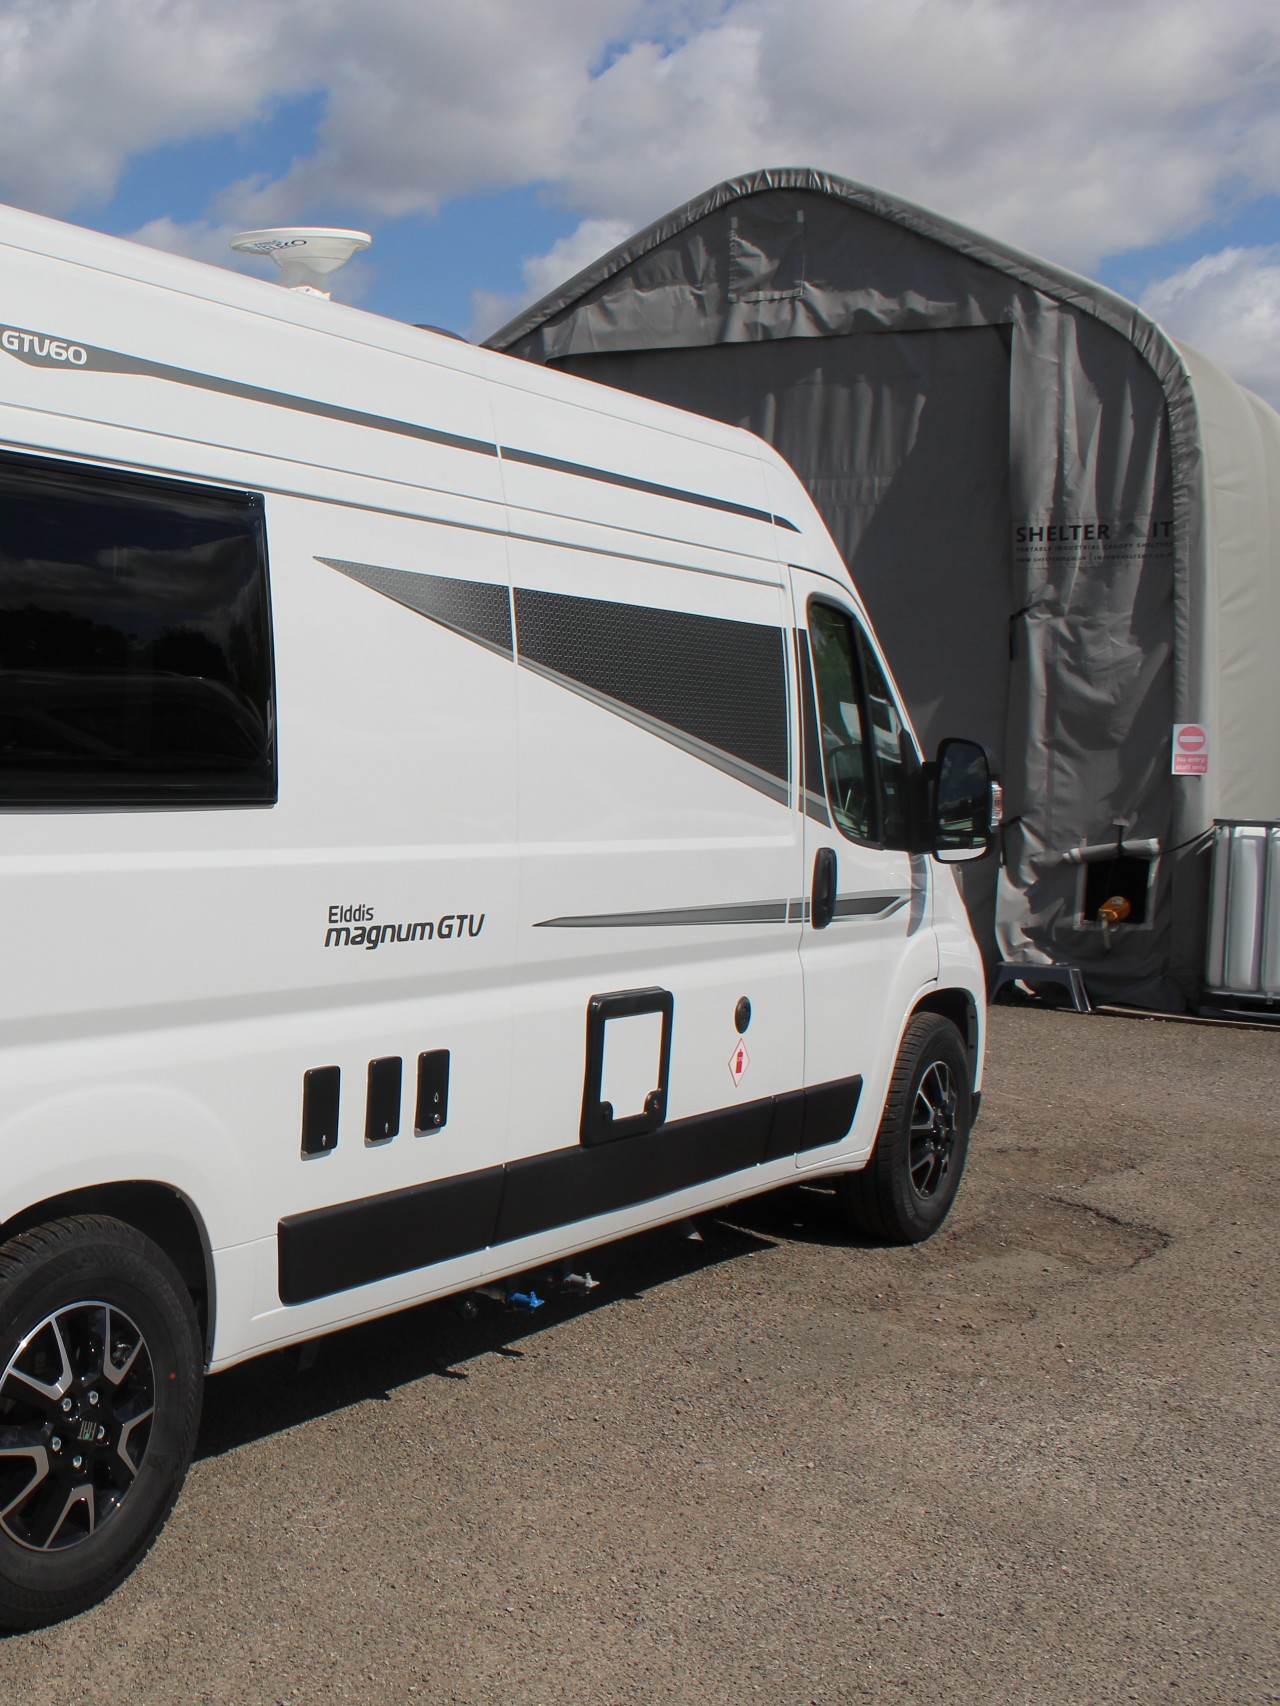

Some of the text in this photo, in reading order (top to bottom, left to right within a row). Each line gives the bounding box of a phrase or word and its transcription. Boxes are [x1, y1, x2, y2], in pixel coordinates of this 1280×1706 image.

[1, 330, 88, 365] GTV60
[1016, 521, 1174, 542] SHELTER IT
[328, 904, 374, 924] Elddis
[324, 913, 486, 950] magnum GTV
